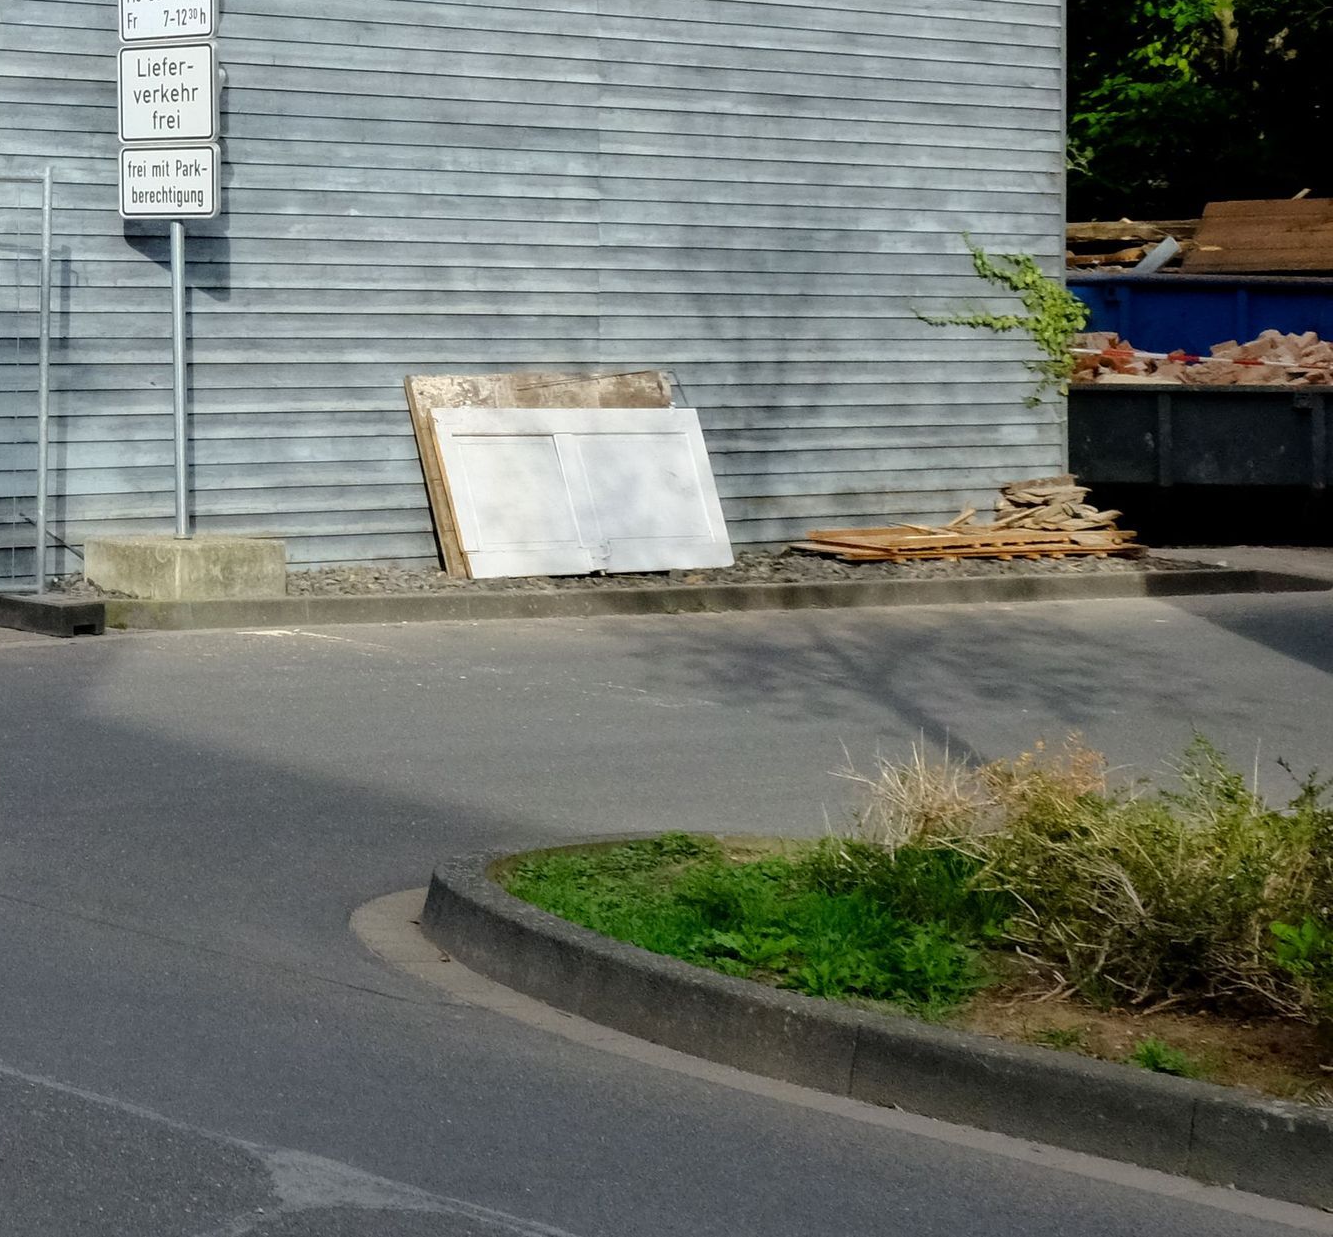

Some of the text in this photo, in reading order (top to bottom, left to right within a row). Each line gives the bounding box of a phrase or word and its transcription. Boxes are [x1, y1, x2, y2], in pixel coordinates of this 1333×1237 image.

[127, 12, 138, 30] Fr
[137, 57, 194, 77] Liefer-
[133, 82, 199, 104] verkehr
[152, 109, 180, 130] frei
[127, 158, 208, 178] frei mit Park-
[131, 185, 204, 208] berechtigung
